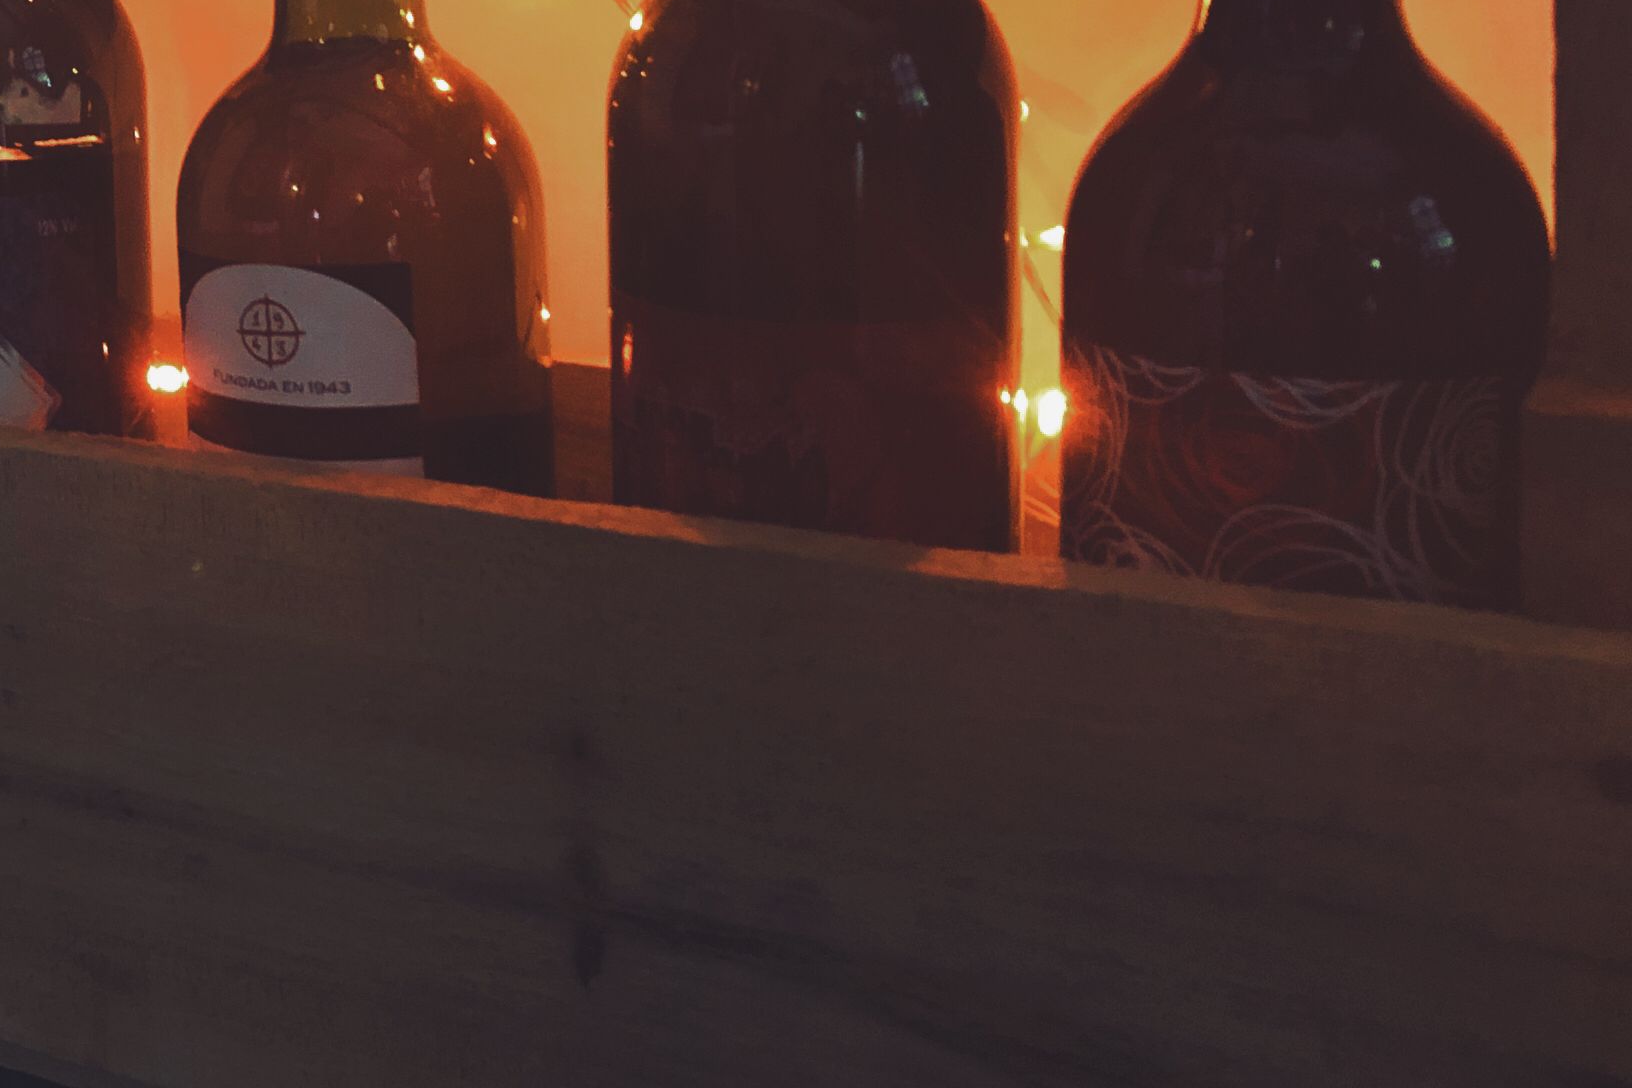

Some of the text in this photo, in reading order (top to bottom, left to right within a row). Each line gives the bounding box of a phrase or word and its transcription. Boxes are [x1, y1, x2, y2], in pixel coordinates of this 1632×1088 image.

[213, 368, 352, 394] FUNDADA EN 1943
